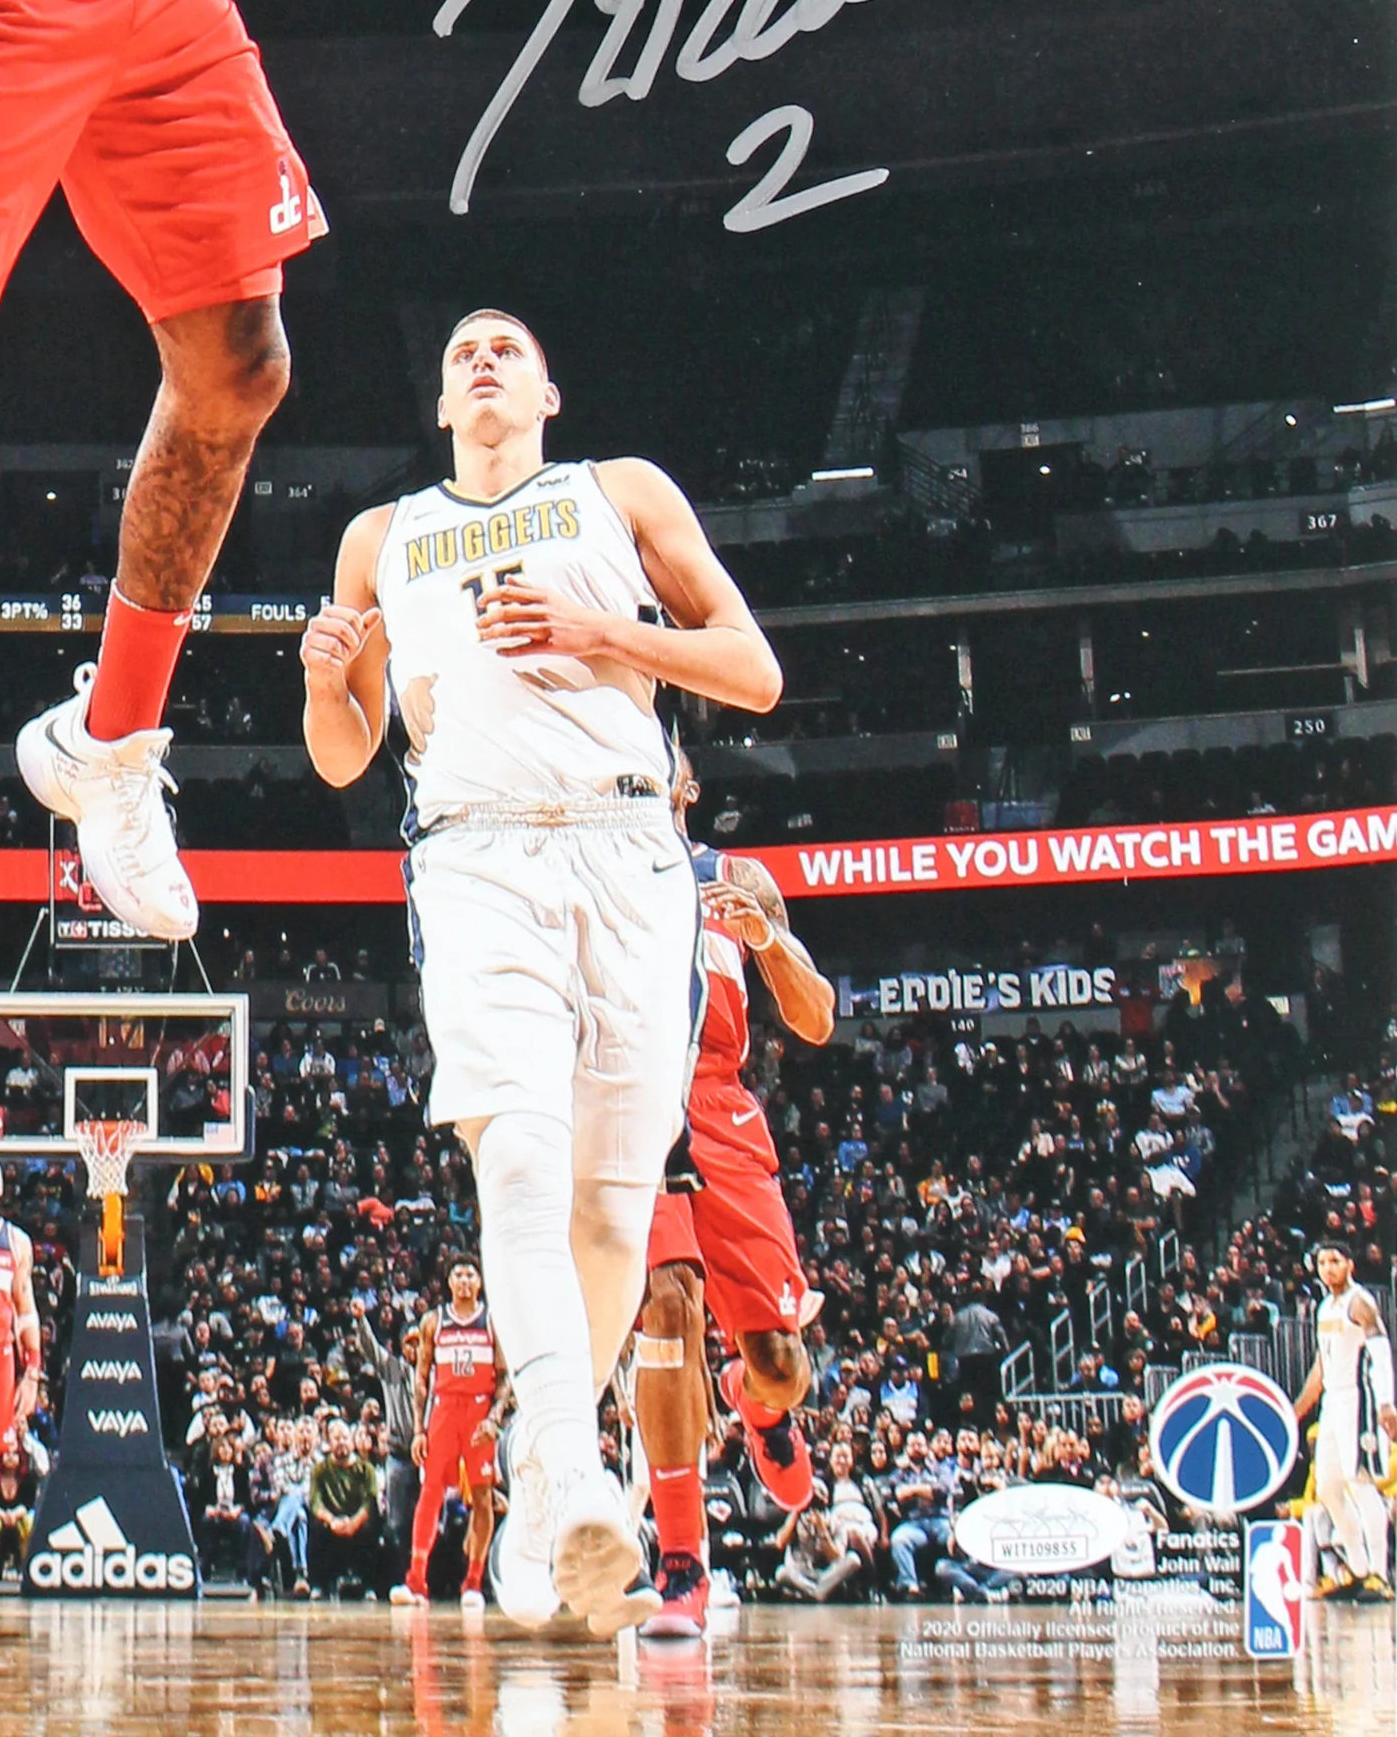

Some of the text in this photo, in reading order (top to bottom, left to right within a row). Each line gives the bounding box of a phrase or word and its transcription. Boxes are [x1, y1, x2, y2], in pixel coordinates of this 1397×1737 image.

[723, 103, 890, 233] 2
[1307, 515, 1337, 529] 367
[406, 499, 580, 583] NUGGETS
[1, 601, 48, 620] 3PT%
[61, 593, 82, 611] 36
[251, 603, 306, 623] FOULS
[1293, 719, 1325, 735] 250
[798, 843, 939, 888] WHILE
[945, 837, 1039, 879] YOU
[1047, 828, 1202, 874] WATCH
[1209, 823, 1299, 865] THE
[1030, 967, 1116, 1007] KIDS
[286, 989, 346, 1013] Coors
[86, 1312, 138, 1333] AVAYA
[81, 1360, 142, 1385] AVAYA
[452, 1348, 475, 1377] 12
[29, 1542, 194, 1590] adidas
